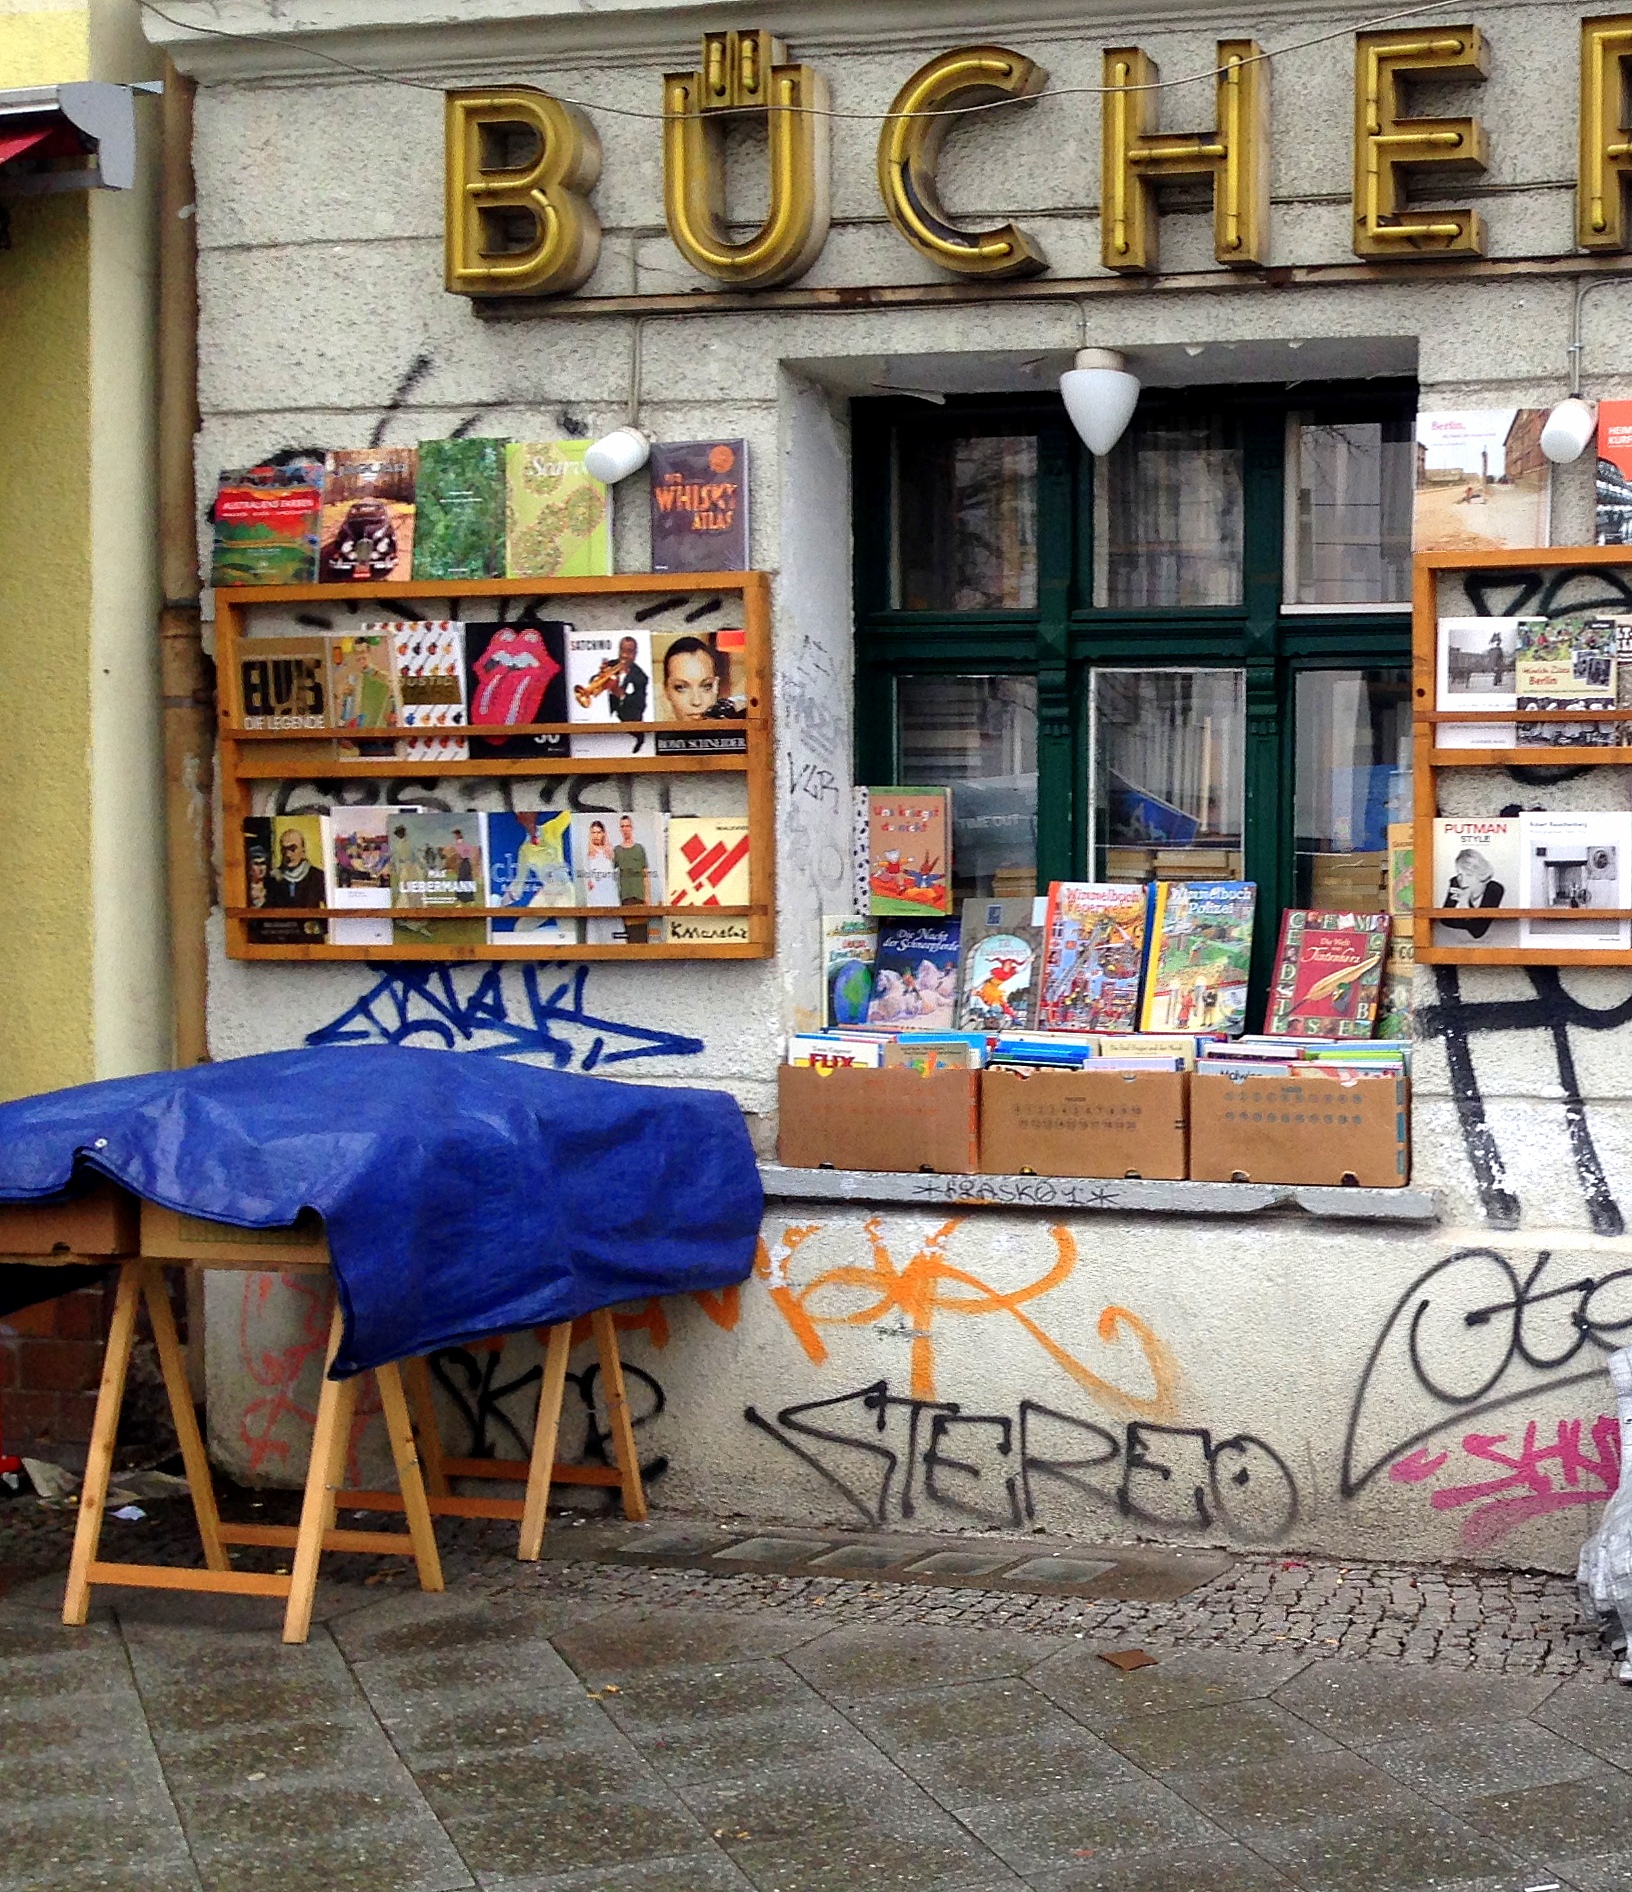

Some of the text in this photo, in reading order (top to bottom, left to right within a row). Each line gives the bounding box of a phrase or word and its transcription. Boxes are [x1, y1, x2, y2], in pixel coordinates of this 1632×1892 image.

[655, 484, 738, 512] WHISKY
[691, 511, 733, 529] ATLAS
[1529, 675, 1557, 685] Berlin
[1444, 823, 1507, 834] PUTMAN
[1460, 835, 1491, 843] STYLE
[399, 880, 478, 893] LIEBERMANN
[1188, 902, 1234, 914] Polizei
